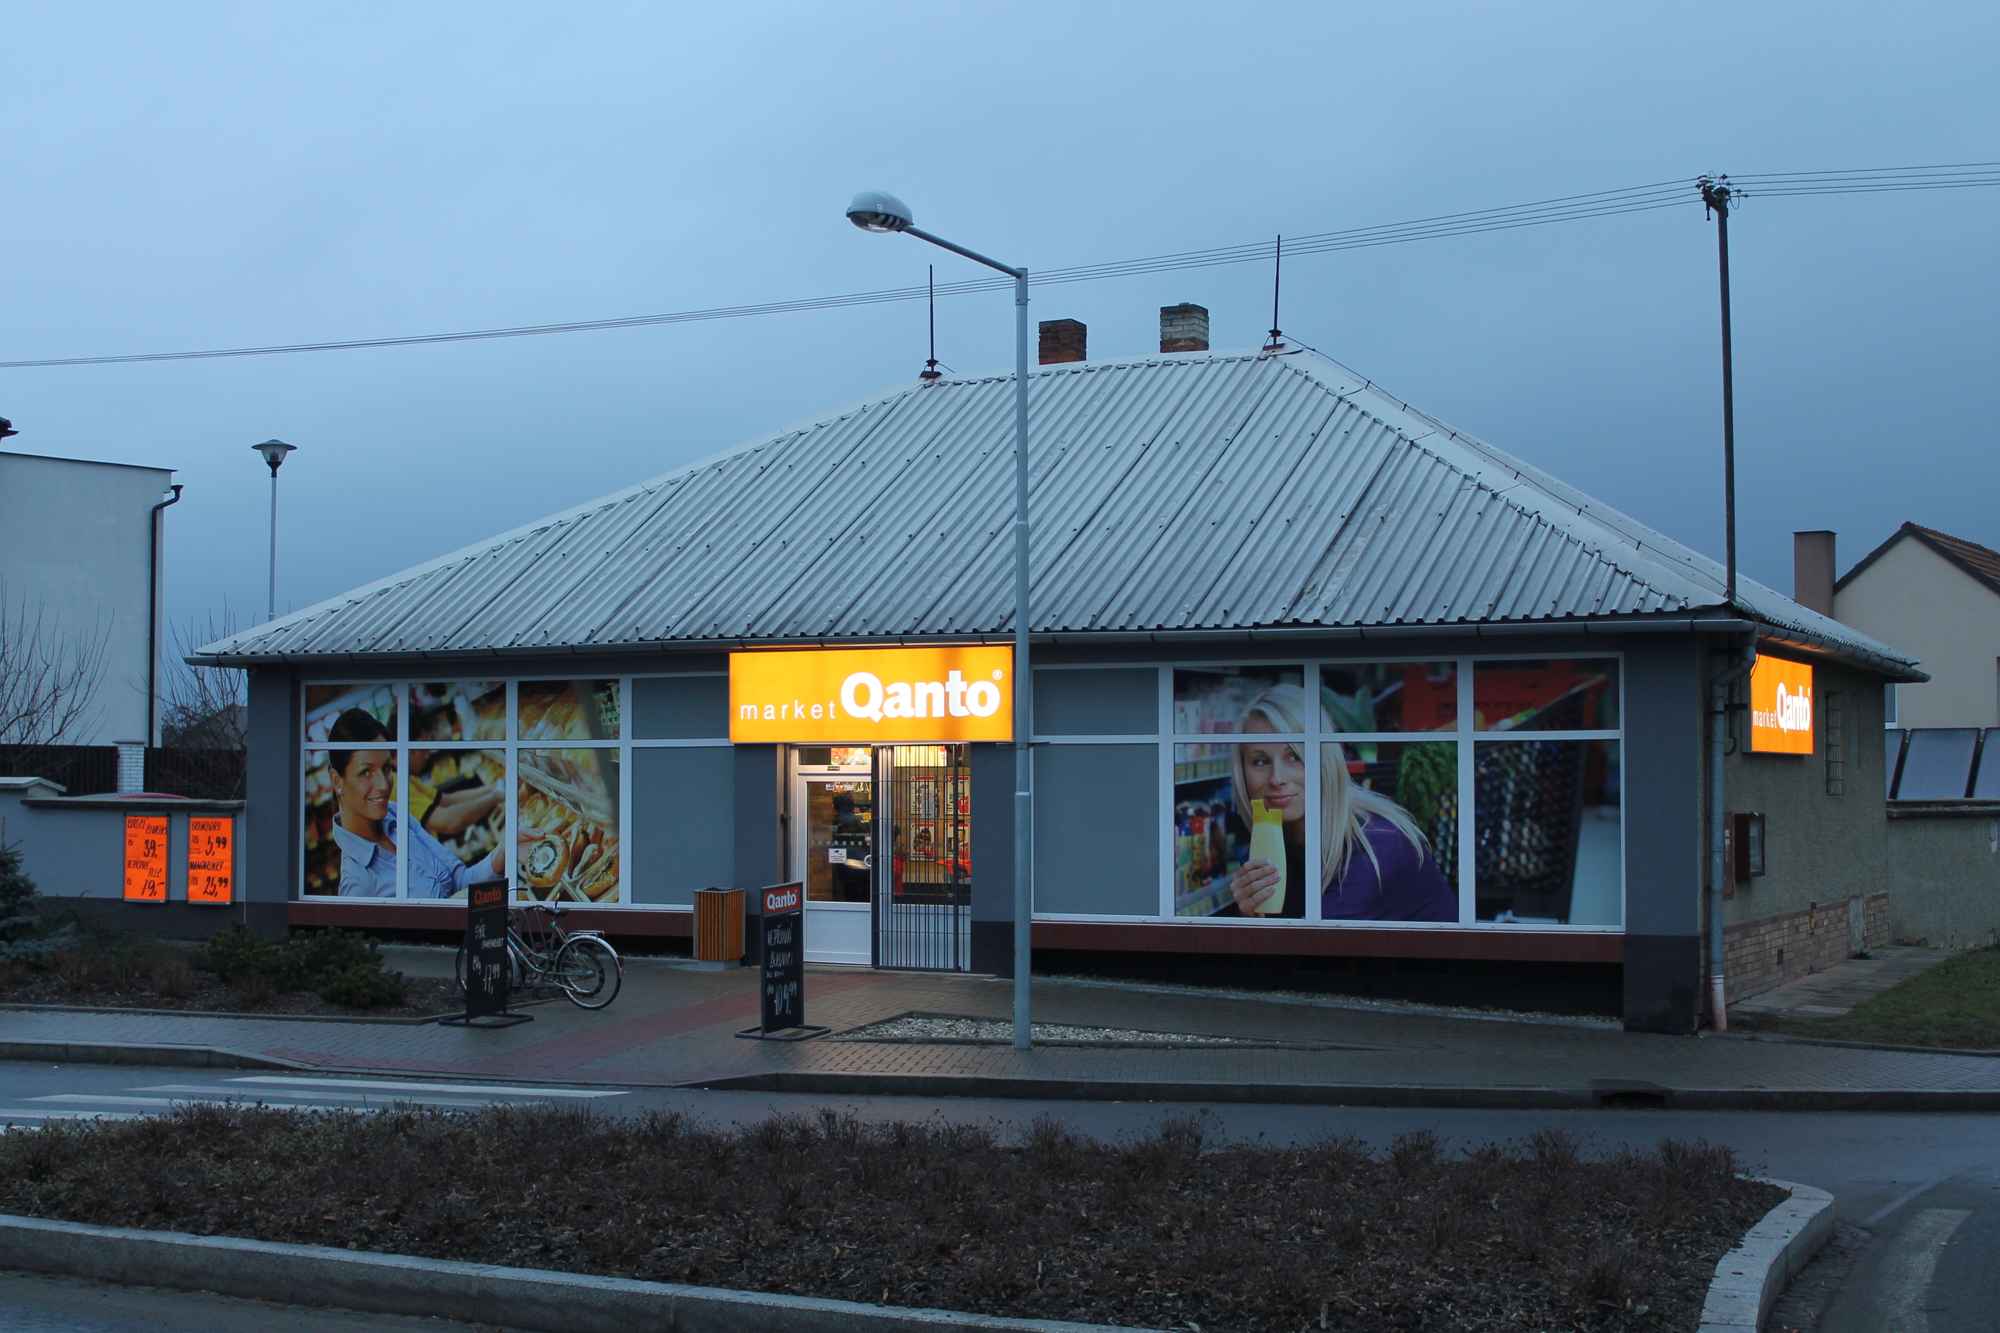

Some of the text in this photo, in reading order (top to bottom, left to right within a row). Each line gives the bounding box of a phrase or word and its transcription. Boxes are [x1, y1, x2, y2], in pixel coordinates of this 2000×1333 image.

[740, 669, 1000, 722] market Qanto
[1776, 682, 1811, 735] Qanto
[767, 890, 797, 910] Qanto
